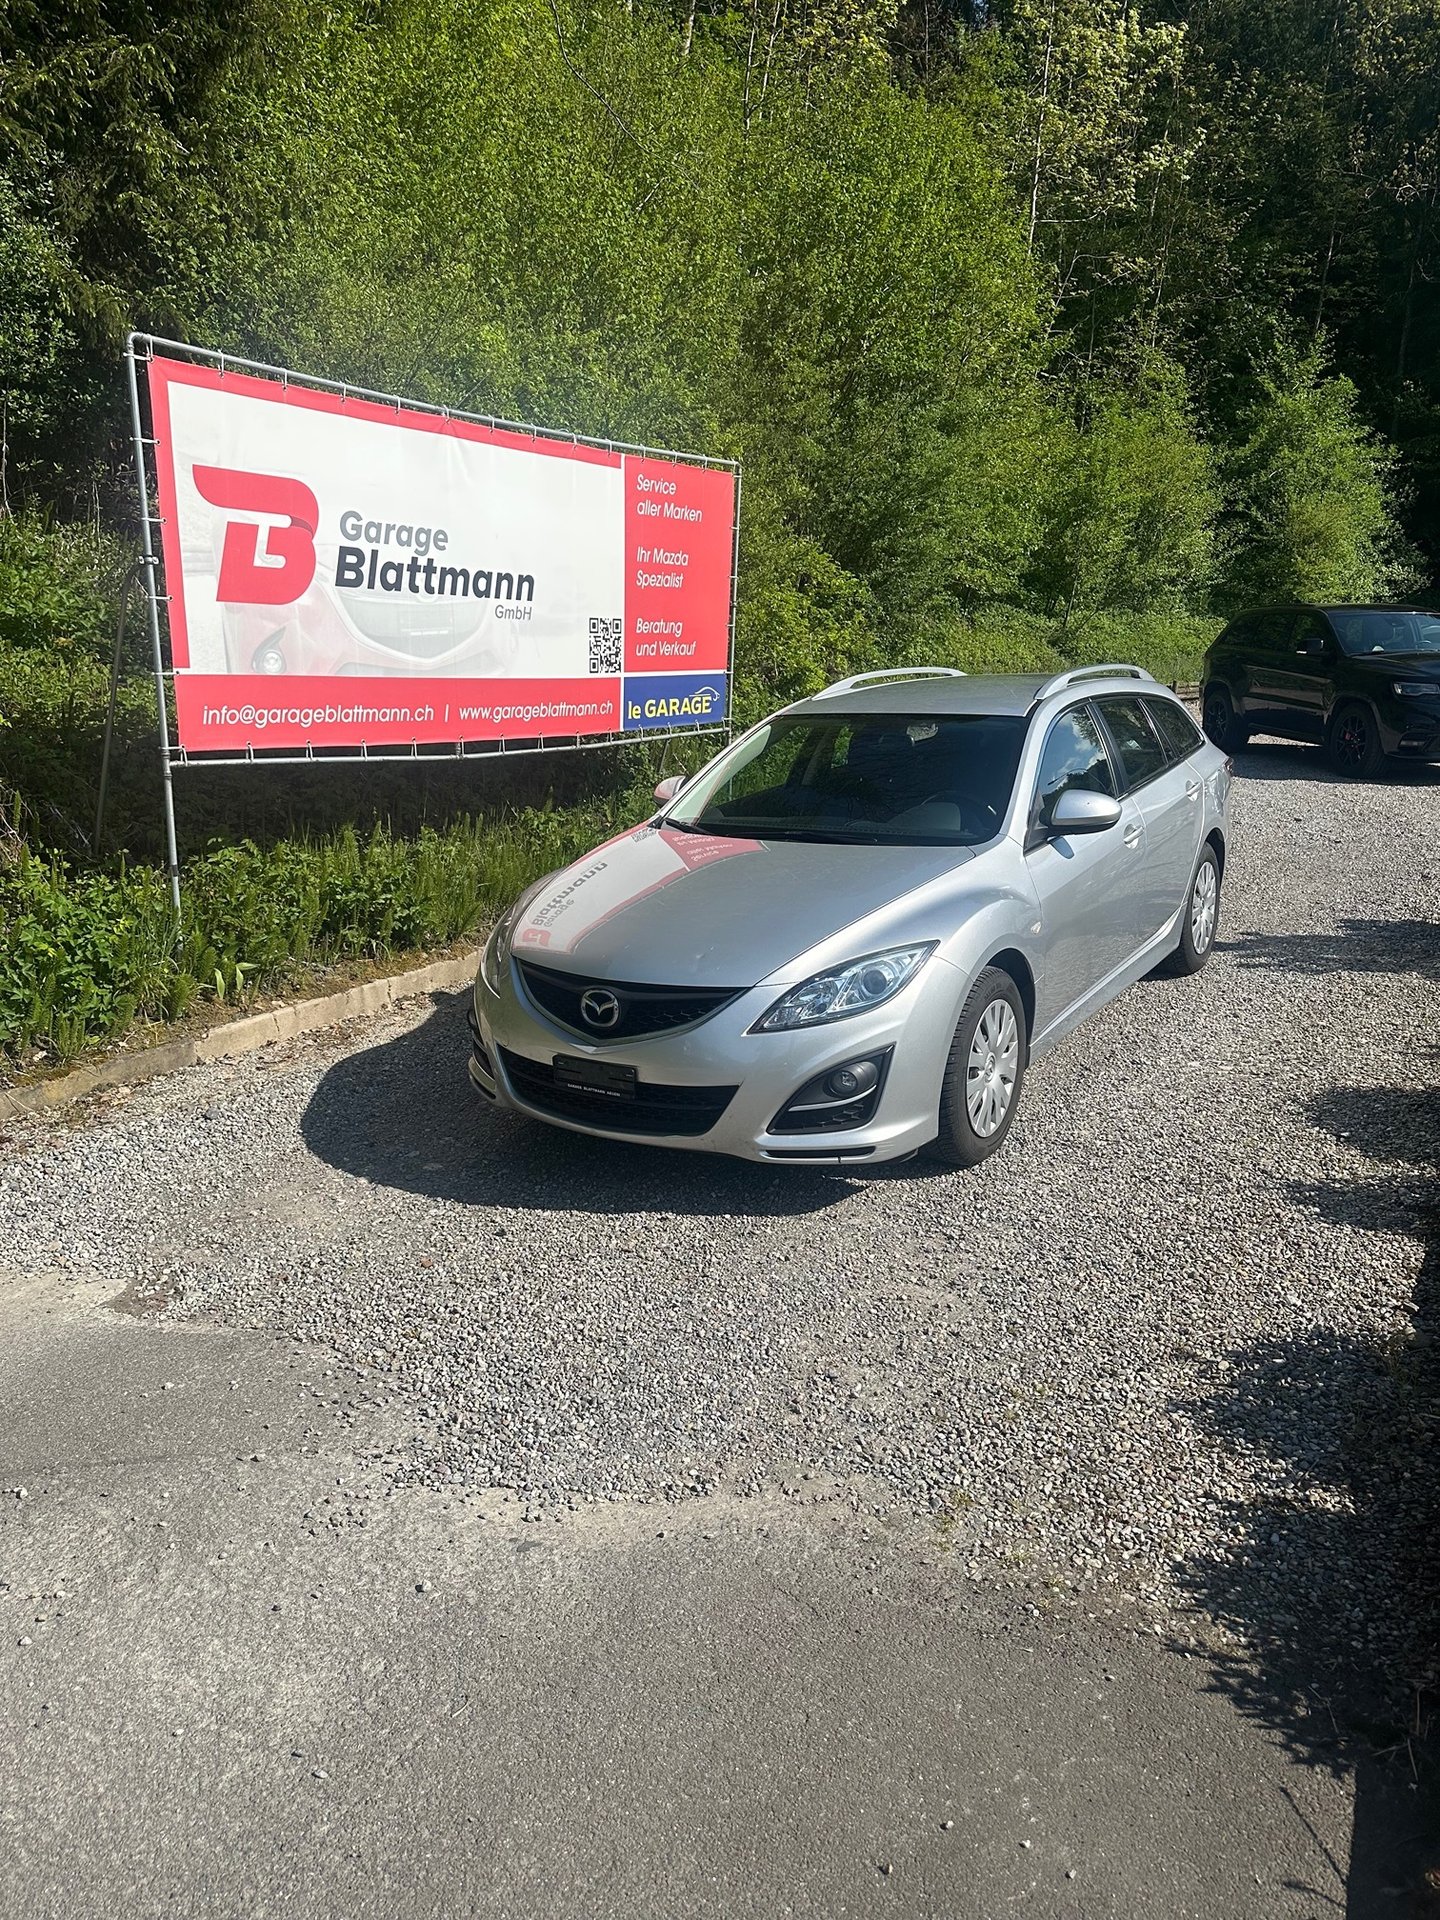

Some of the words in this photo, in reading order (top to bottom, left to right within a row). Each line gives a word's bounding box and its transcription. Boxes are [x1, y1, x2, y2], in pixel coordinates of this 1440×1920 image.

[636, 474, 677, 495] Service
[637, 500, 661, 518] aller
[664, 502, 703, 522] Marken
[339, 510, 449, 556] Garage
[636, 547, 651, 564] Ihr
[653, 548, 689, 566] Mazda
[335, 546, 535, 602] Blattmann
[636, 571, 684, 590] Spezialist
[494, 604, 533, 621] GmbH
[636, 618, 683, 637] Beratung
[636, 642, 658, 657] und
[659, 641, 697, 657] Verkauf
[202, 704, 434, 728] info@garageblattmann.ch
[459, 701, 613, 723] www.garageblattmann.ch
[627, 701, 641, 720] le
[644, 695, 712, 718] GARAGE
